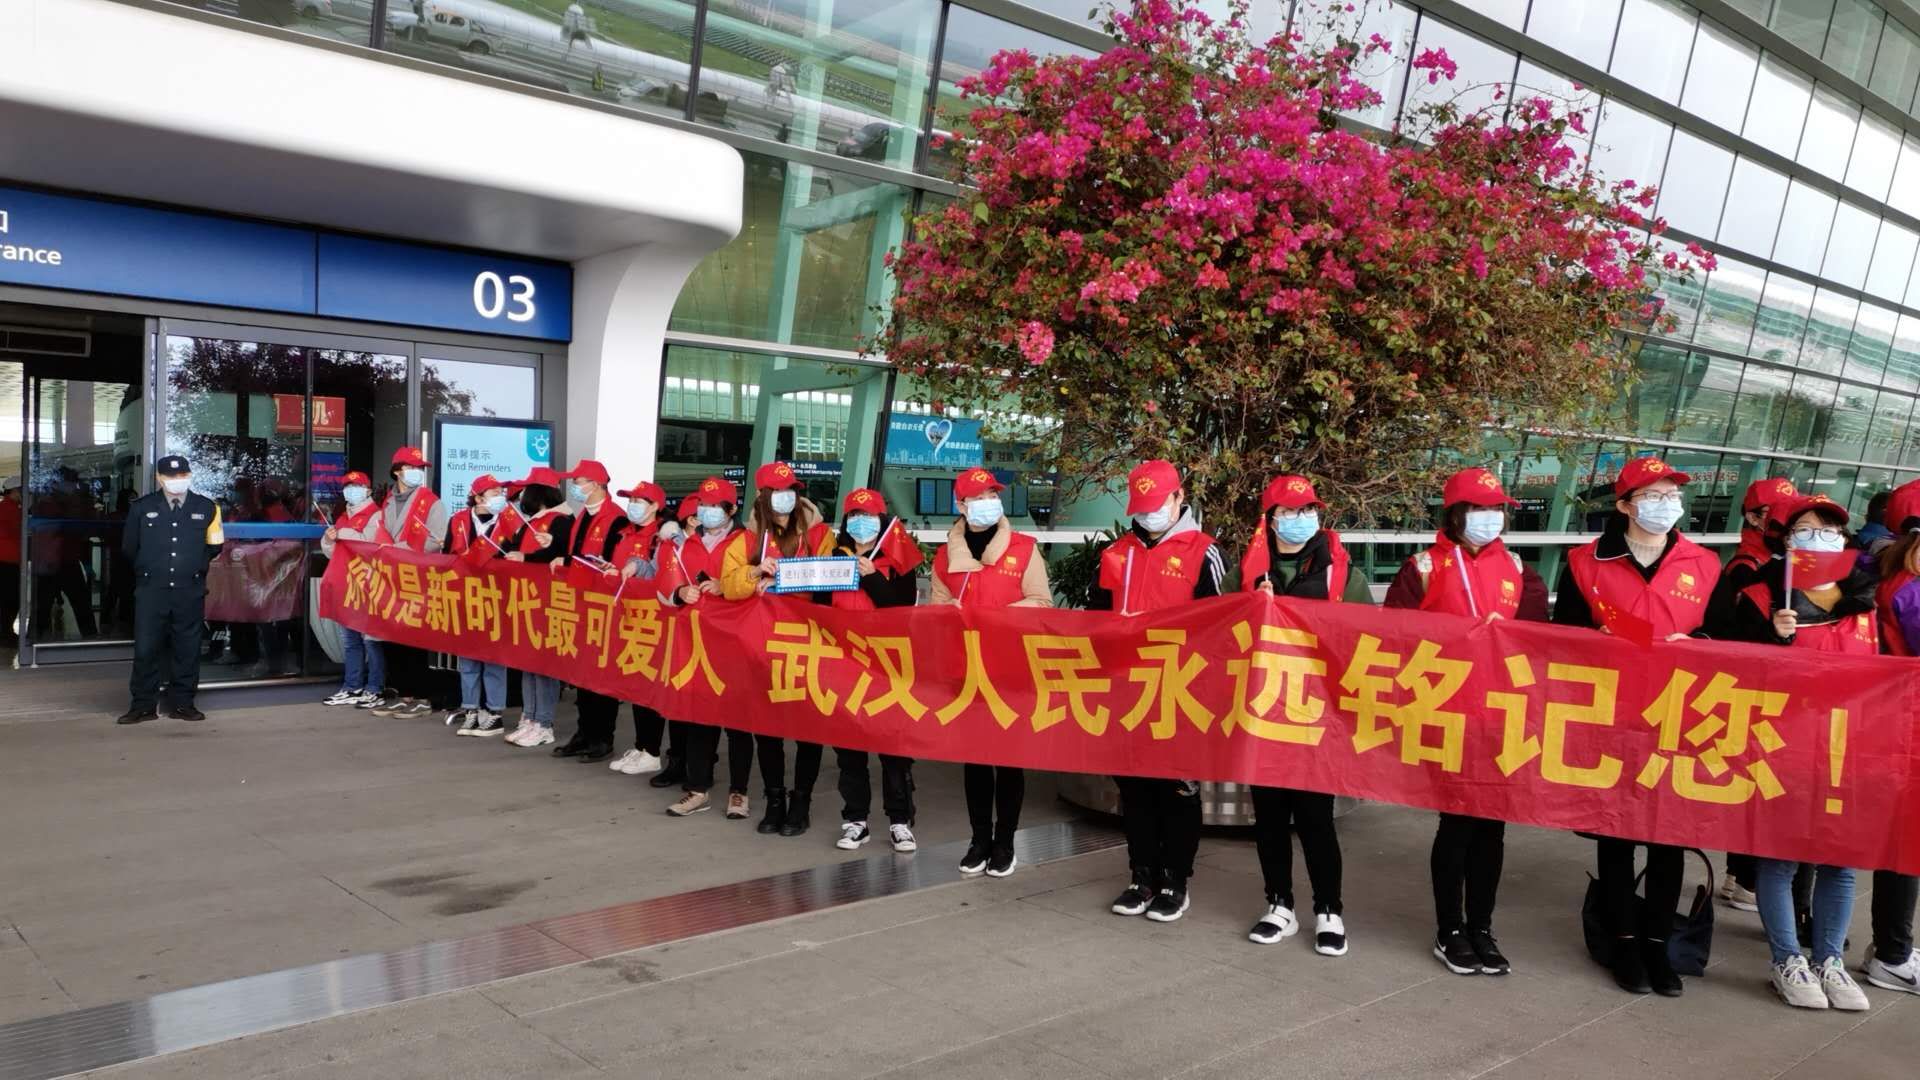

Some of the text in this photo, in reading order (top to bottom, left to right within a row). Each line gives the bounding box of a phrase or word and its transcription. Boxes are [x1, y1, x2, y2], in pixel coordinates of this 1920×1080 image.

[0, 244, 62, 265] ance
[473, 271, 536, 322] 03
[447, 448, 491, 461] 温馨提示
[447, 461, 512, 473] Kind Reminders
[343, 555, 726, 696] 你们是新时代最可爱人
